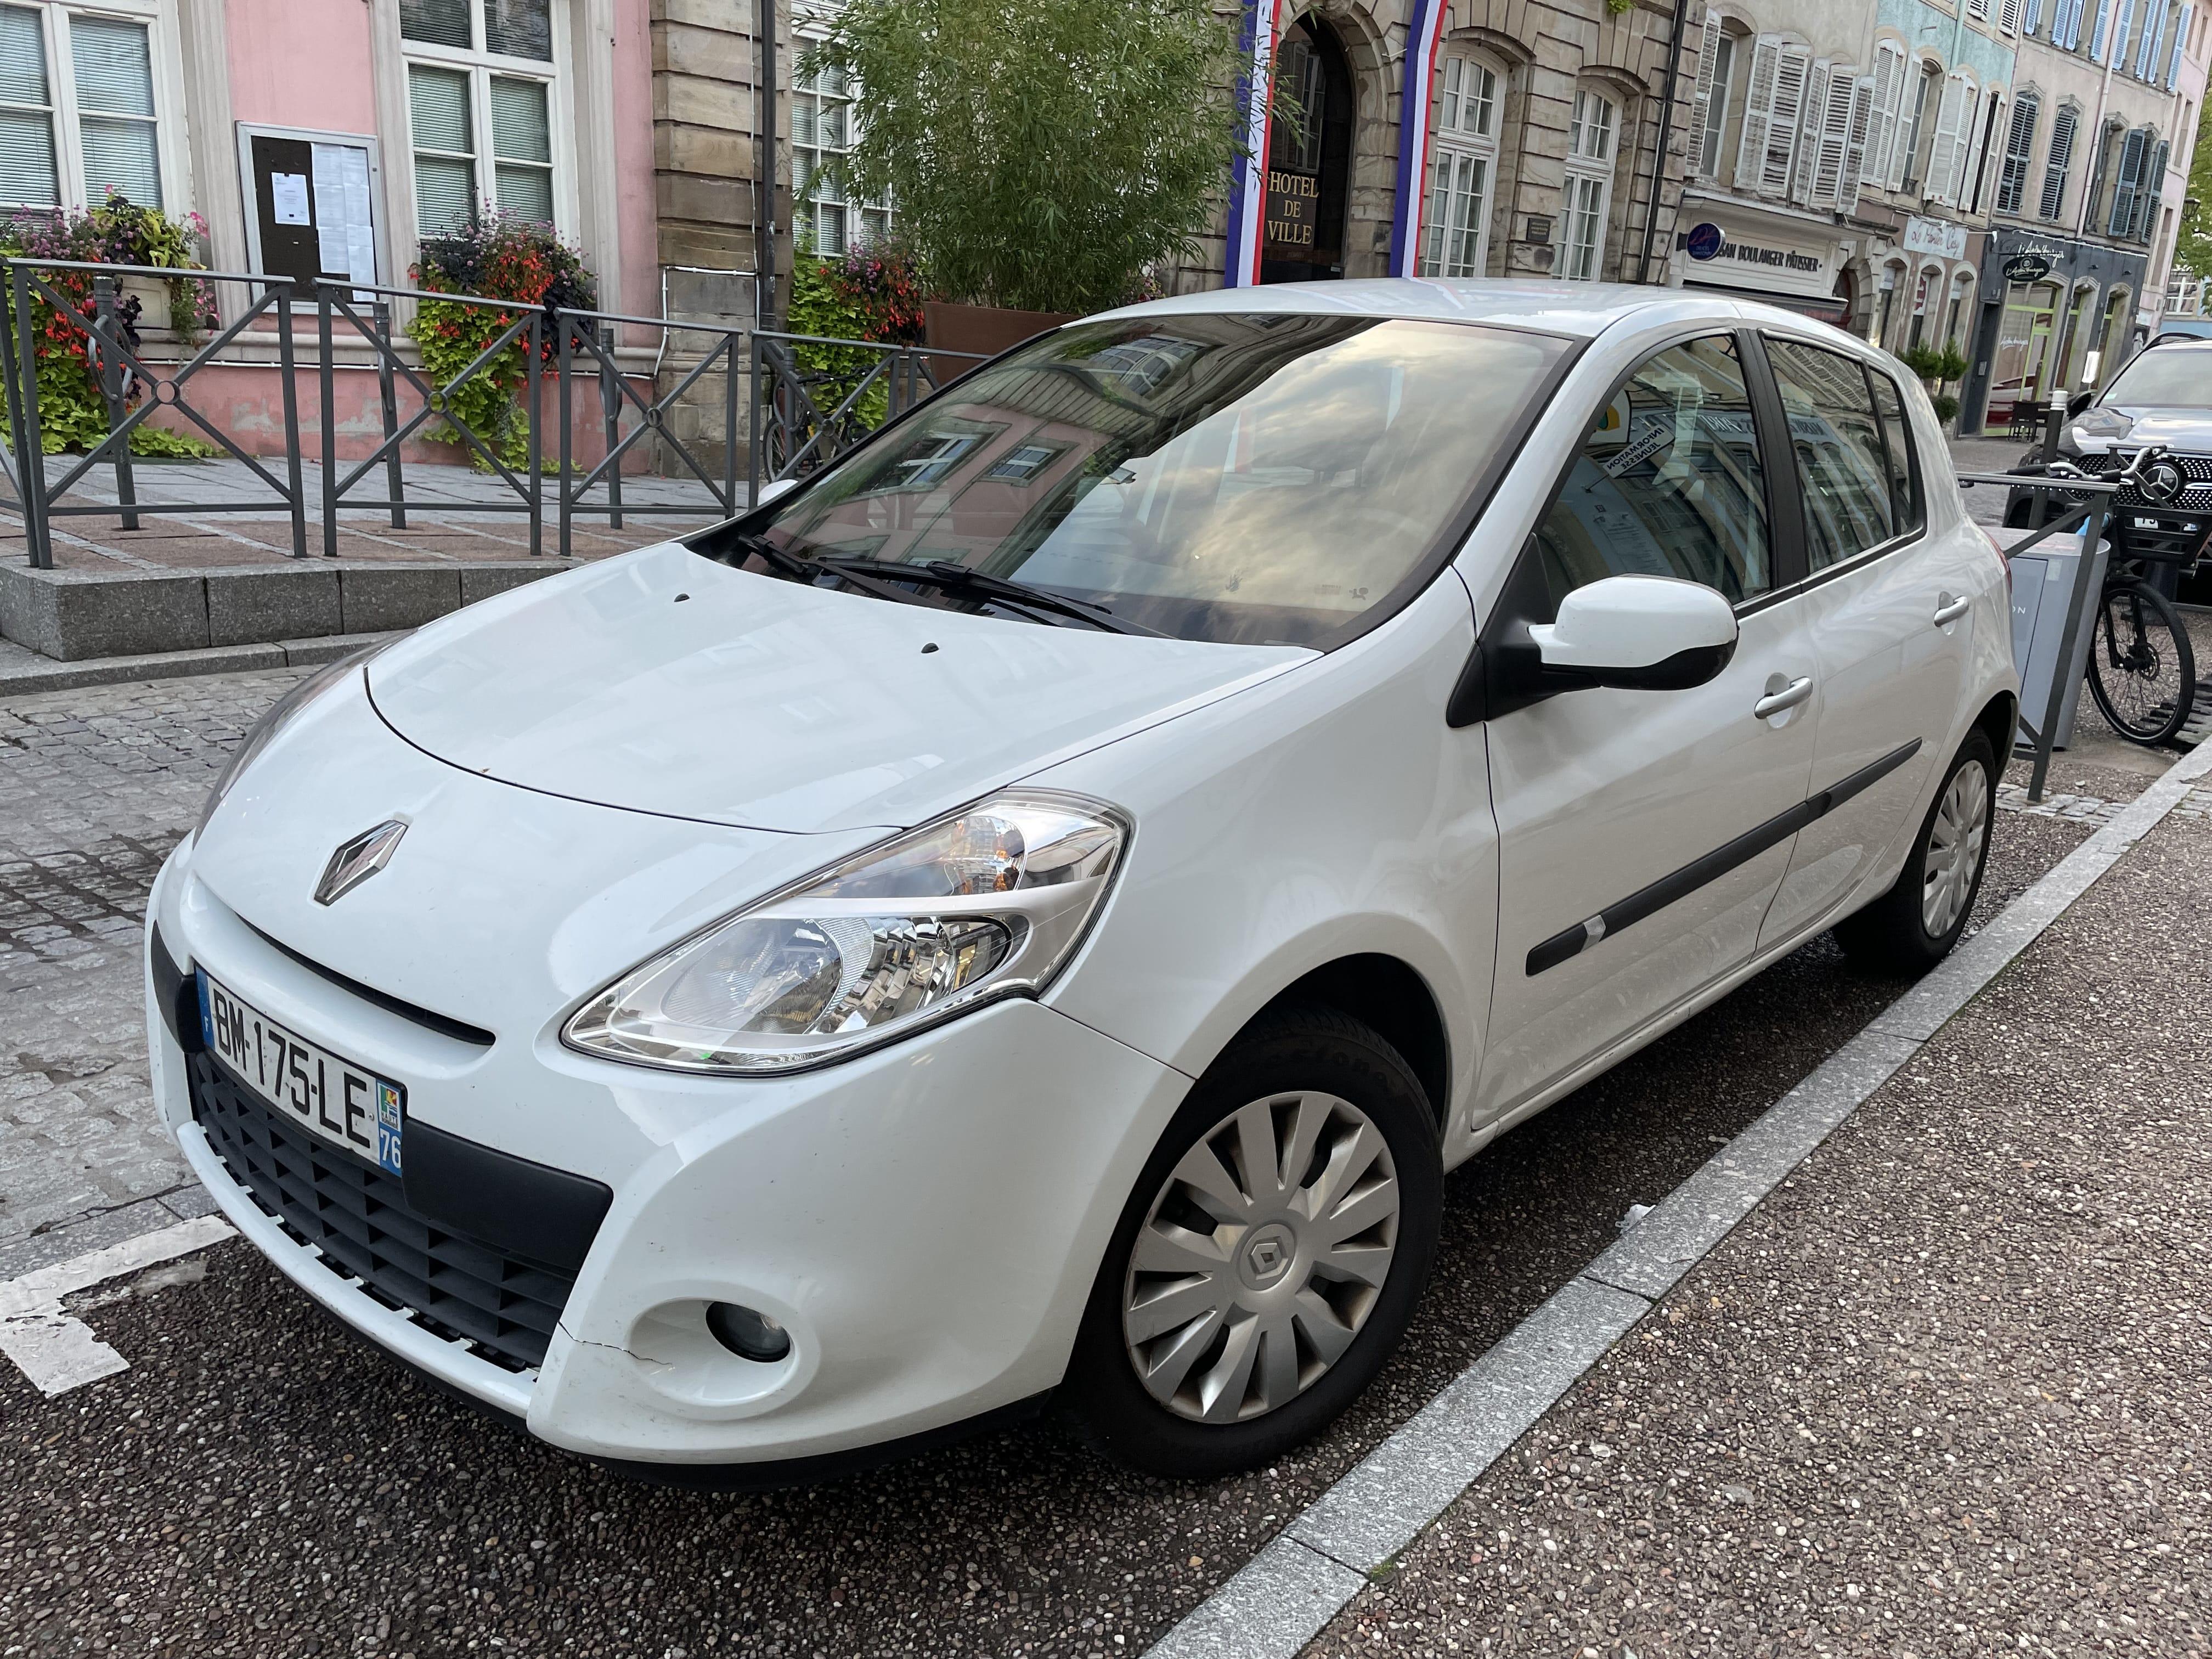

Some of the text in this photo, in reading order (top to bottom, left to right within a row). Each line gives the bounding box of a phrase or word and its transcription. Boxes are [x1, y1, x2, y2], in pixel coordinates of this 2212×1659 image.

[1269, 171, 1319, 198] HOTEL
[1283, 200, 1301, 218] DE
[1268, 221, 1312, 244] VILLE
[1738, 245, 1784, 267] BOULANGER
[204, 1015, 210, 1032] F
[380, 1127, 402, 1169] 76
